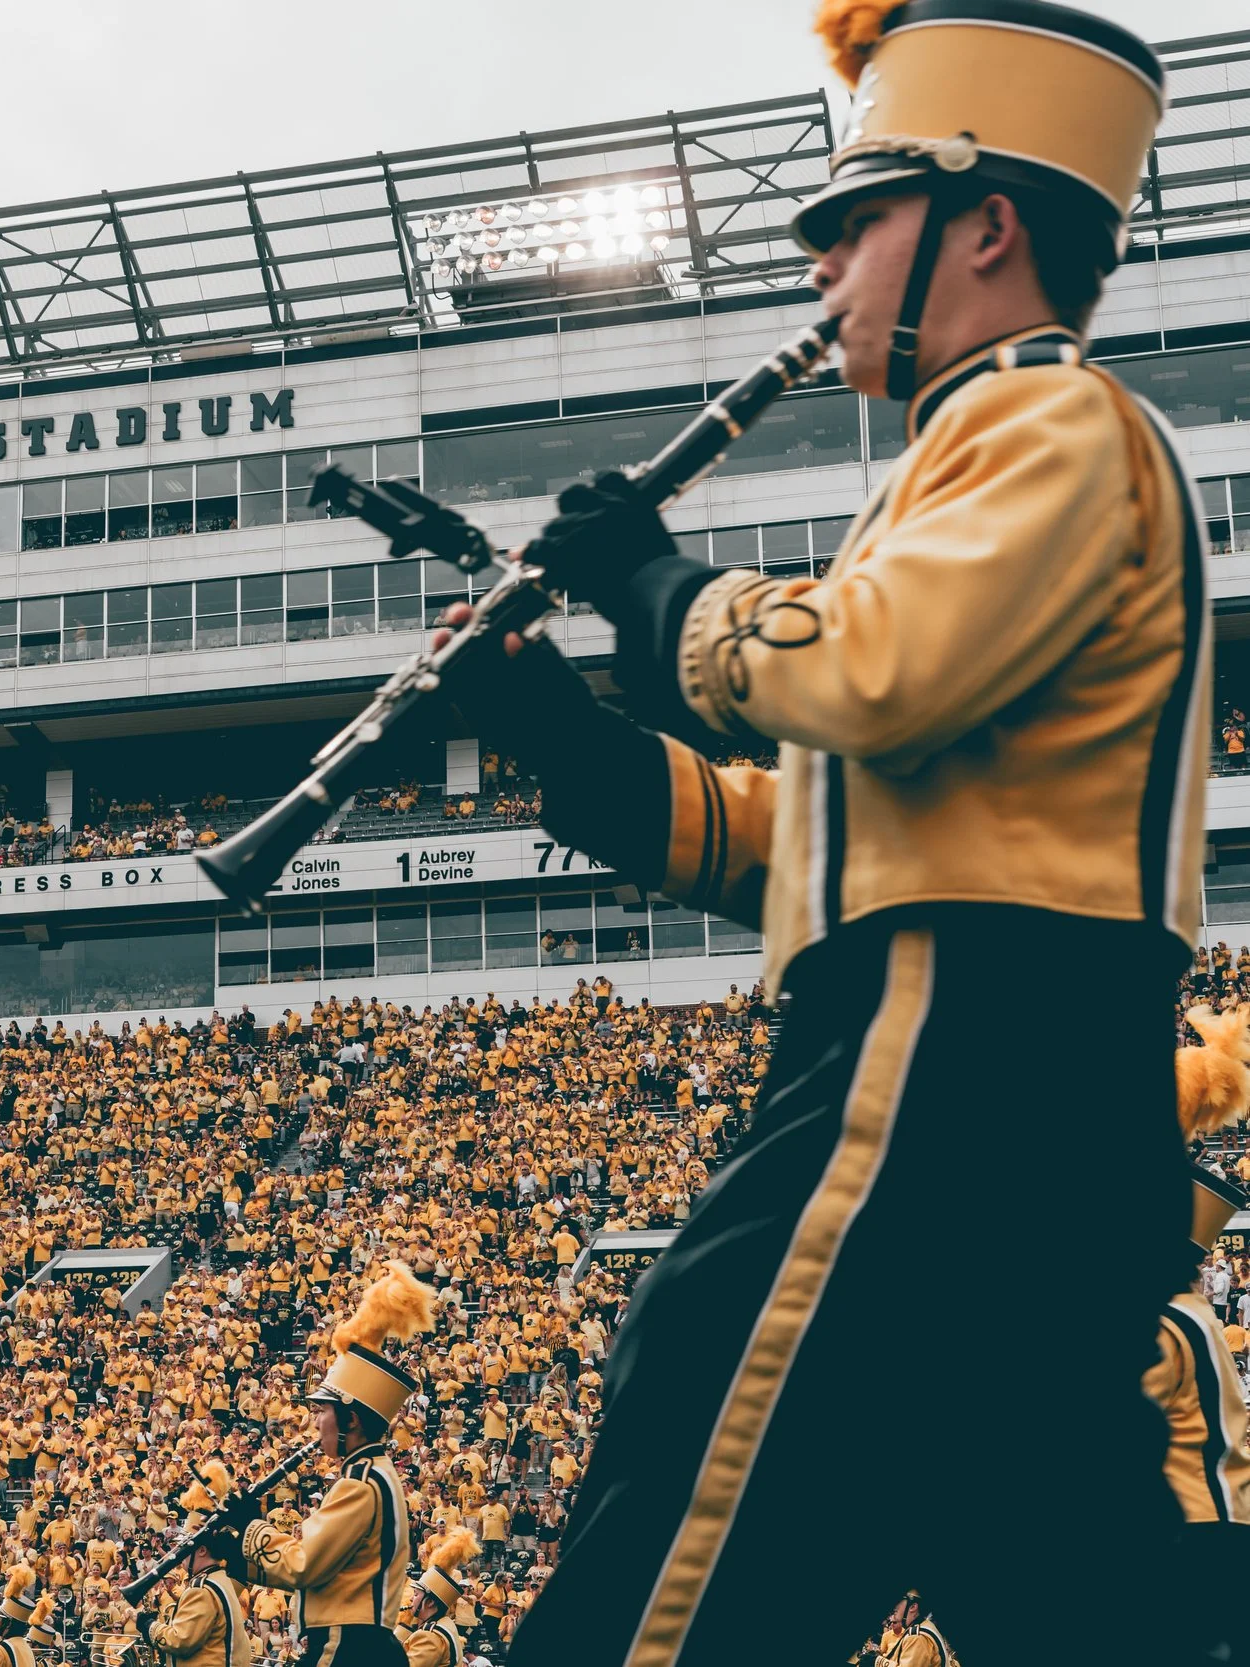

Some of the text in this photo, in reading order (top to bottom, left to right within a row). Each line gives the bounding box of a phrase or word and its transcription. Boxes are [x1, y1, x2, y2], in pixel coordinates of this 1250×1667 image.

[419, 849, 476, 865] Aubrey
[292, 859, 340, 874] Calvin
[397, 853, 410, 882] 1
[419, 866, 473, 881] Devine
[102, 868, 163, 887] BOX
[292, 877, 340, 890] Jones
[1212, 1235, 1245, 1251] 29
[604, 1253, 636, 1269] 128
